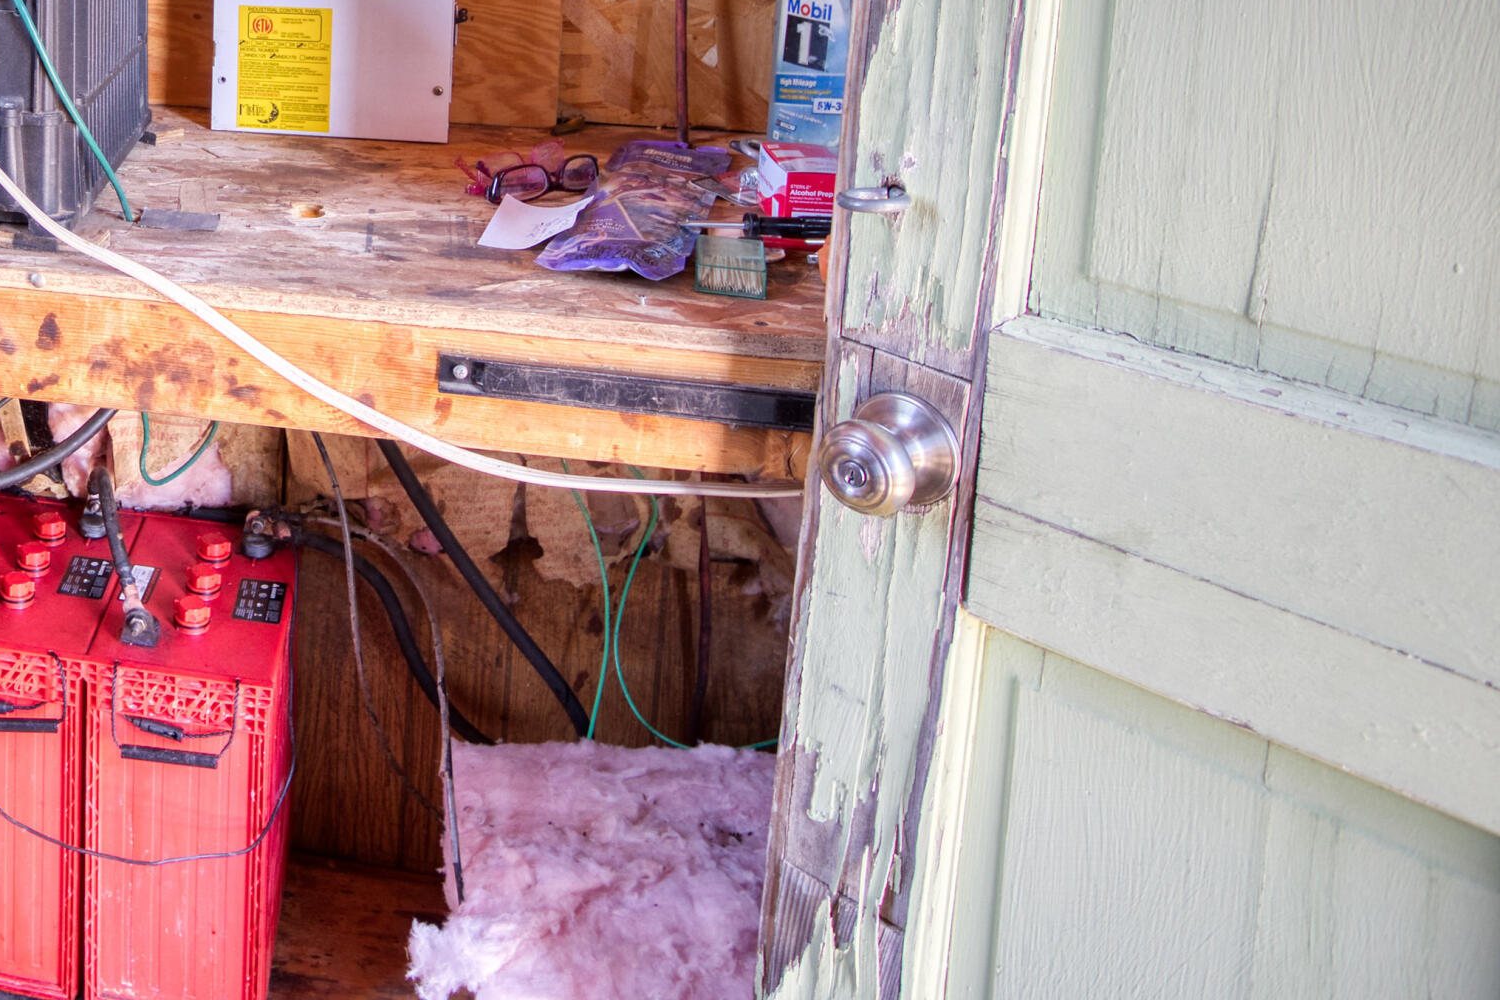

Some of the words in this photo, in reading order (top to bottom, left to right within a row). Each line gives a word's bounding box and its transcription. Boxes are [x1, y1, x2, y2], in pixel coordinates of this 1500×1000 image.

[796, 21, 813, 66] 1
[780, 78, 792, 87] High
[792, 78, 817, 88] Mileage
[817, 190, 834, 198] Prep
